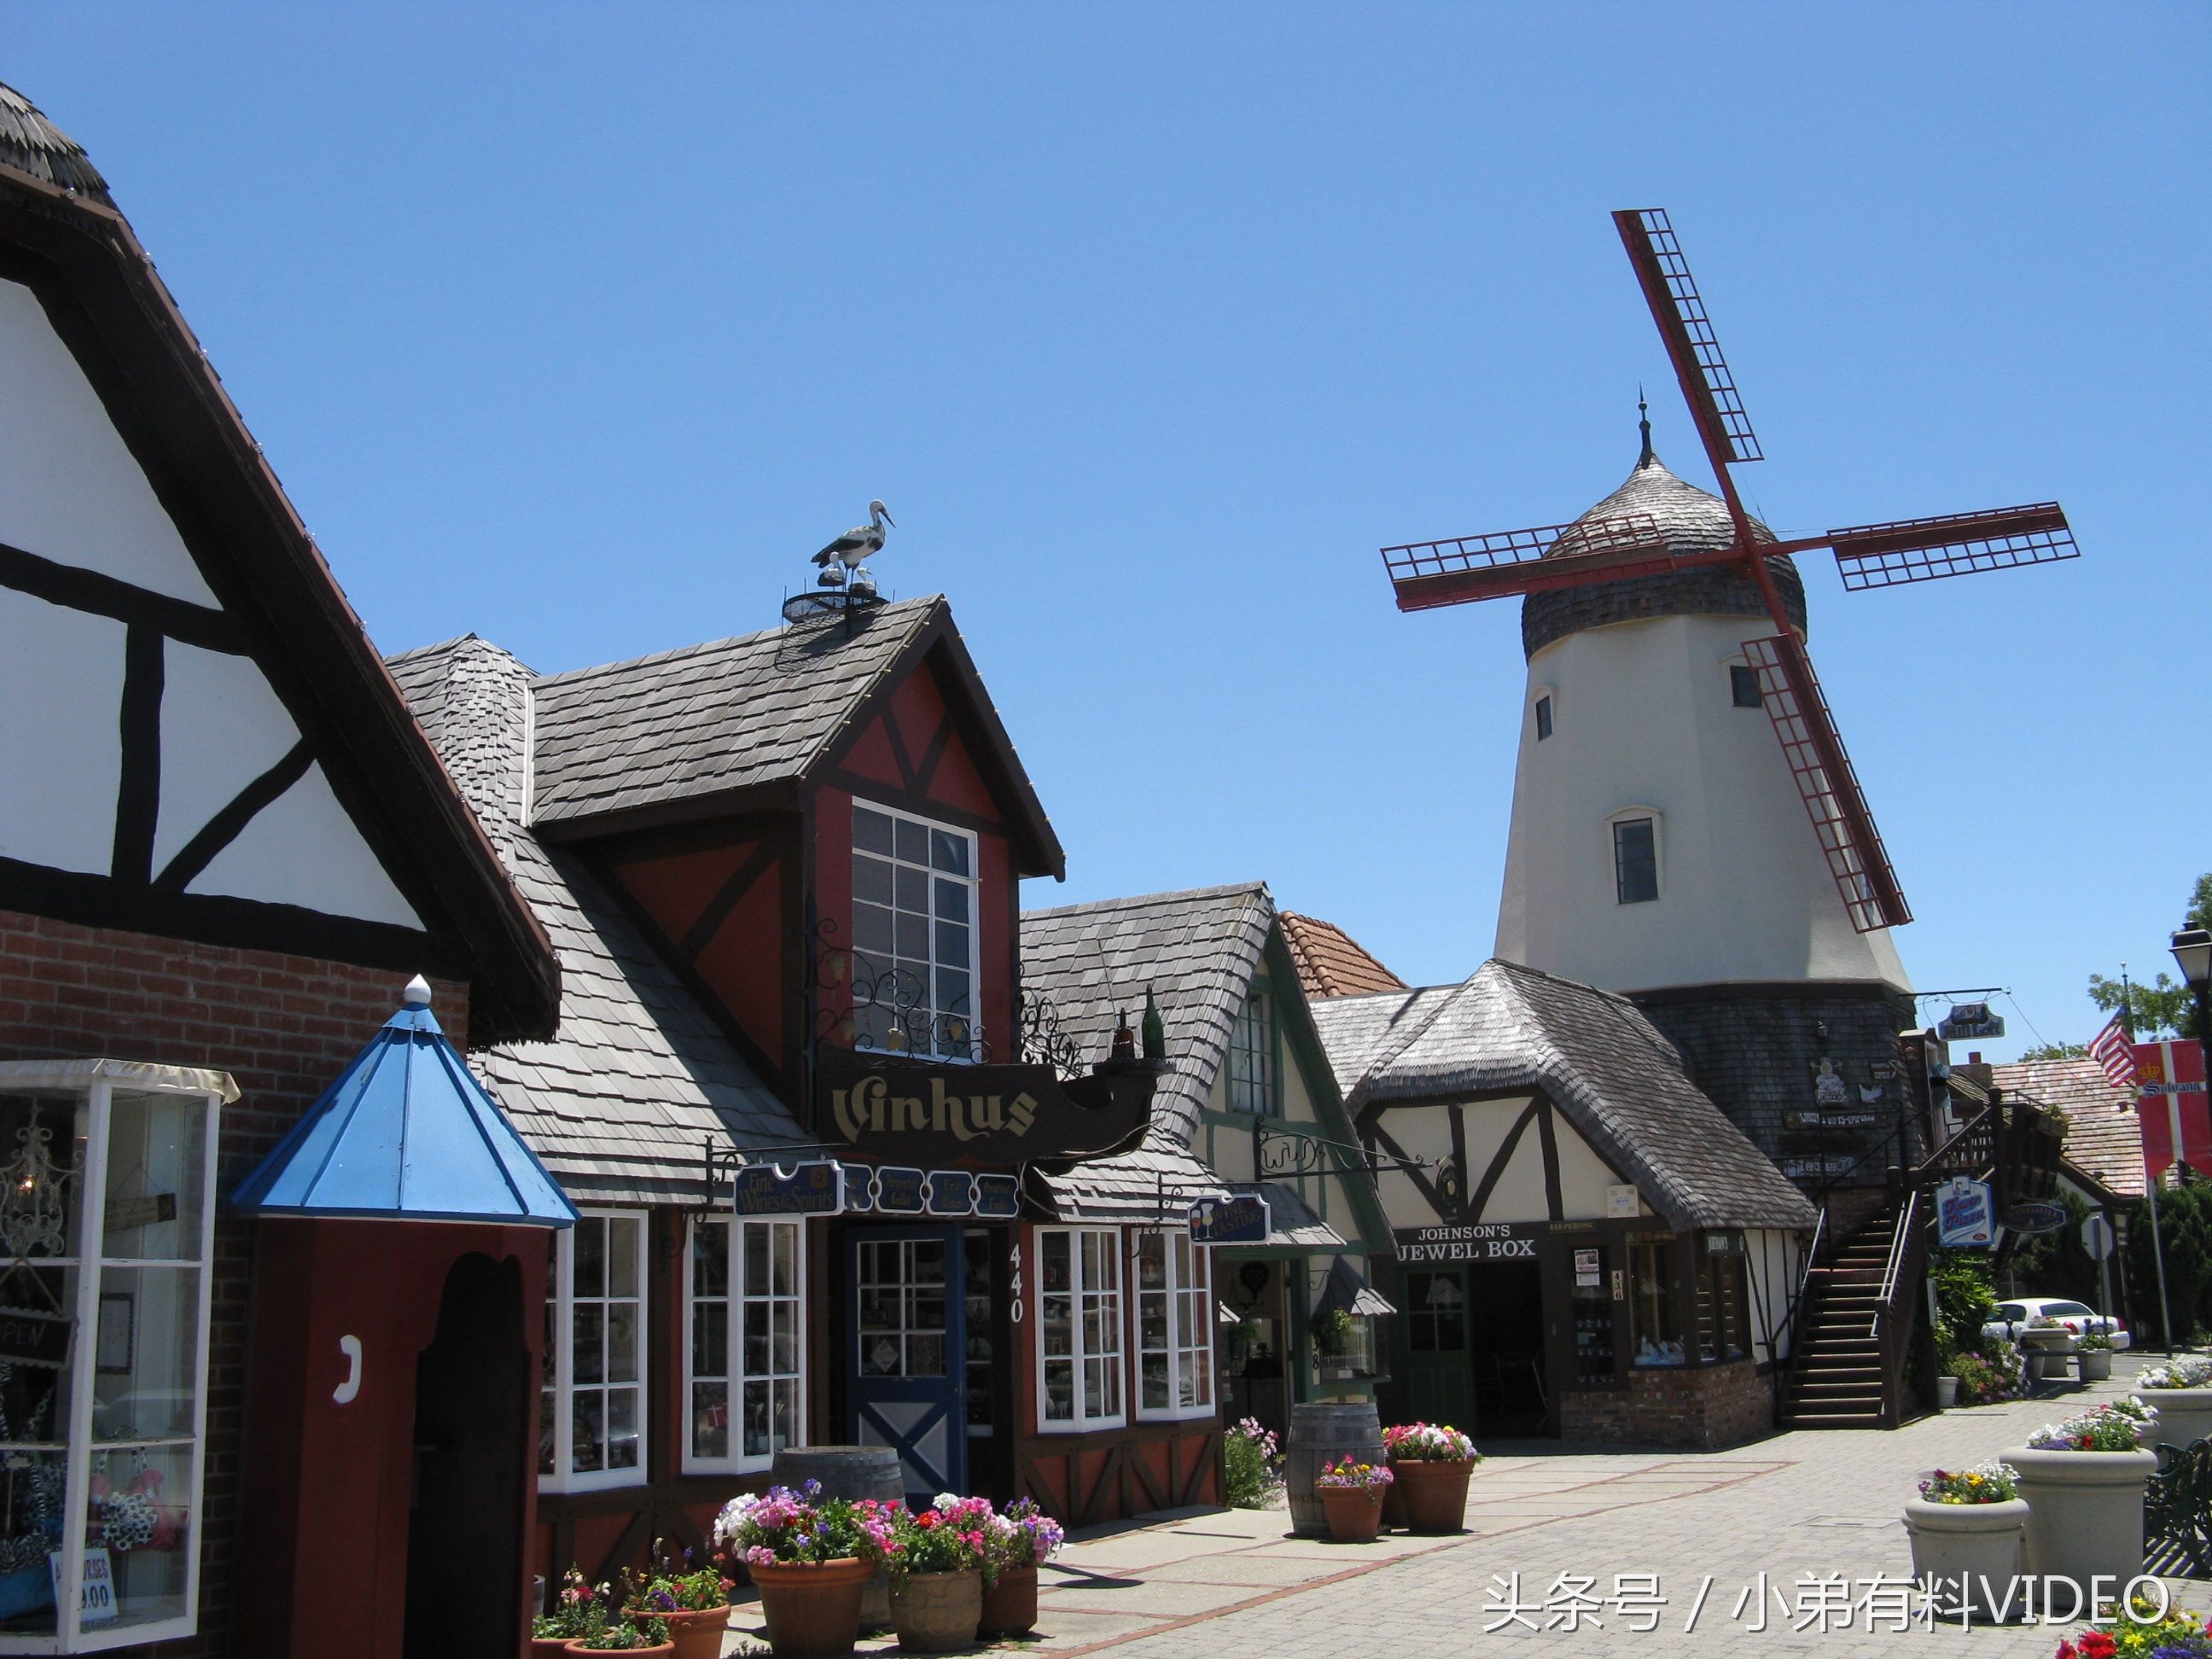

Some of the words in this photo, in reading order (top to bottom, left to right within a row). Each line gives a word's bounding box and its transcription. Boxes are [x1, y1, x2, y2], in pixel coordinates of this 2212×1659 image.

[832, 1076, 1038, 1142] Vinhus
[738, 1189, 780, 1212] Wines
[790, 1186, 834, 1211] Spirits
[1212, 1201, 1246, 1221] WINE
[1210, 1210, 1261, 1236] TASTING
[1418, 1225, 1511, 1240] JOHNSON'S
[1397, 1243, 1479, 1260] JEWEL
[1487, 1239, 1536, 1257] BOX
[1010, 1243, 1023, 1323] 440
[0, 1322, 46, 1347] PEN
